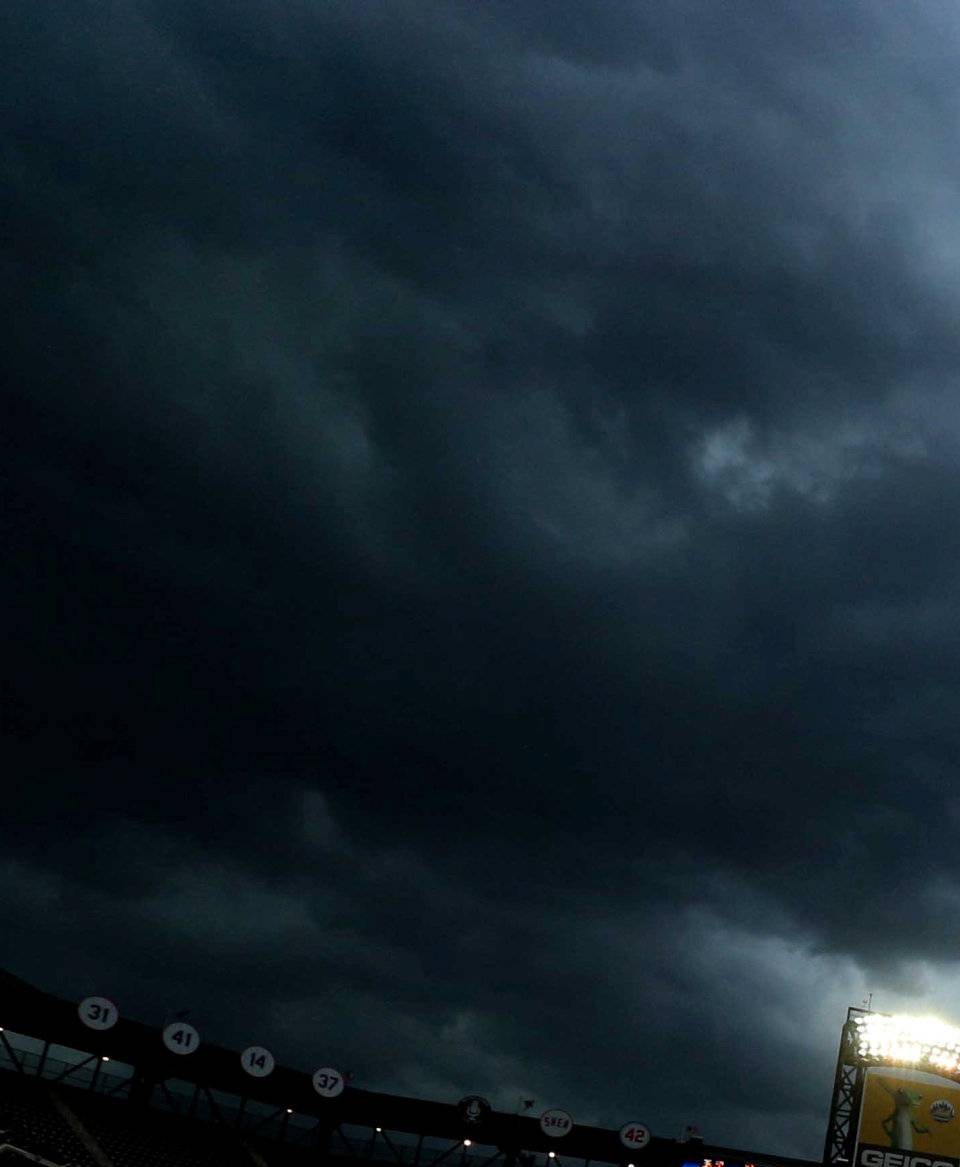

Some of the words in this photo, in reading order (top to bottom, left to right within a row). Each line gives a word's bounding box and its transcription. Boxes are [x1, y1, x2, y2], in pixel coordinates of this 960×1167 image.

[87, 1004, 109, 1023] 31
[171, 1030, 192, 1047] 41
[249, 1052, 266, 1069] 14
[317, 1074, 339, 1091] 37
[626, 1128, 645, 1143] 42
